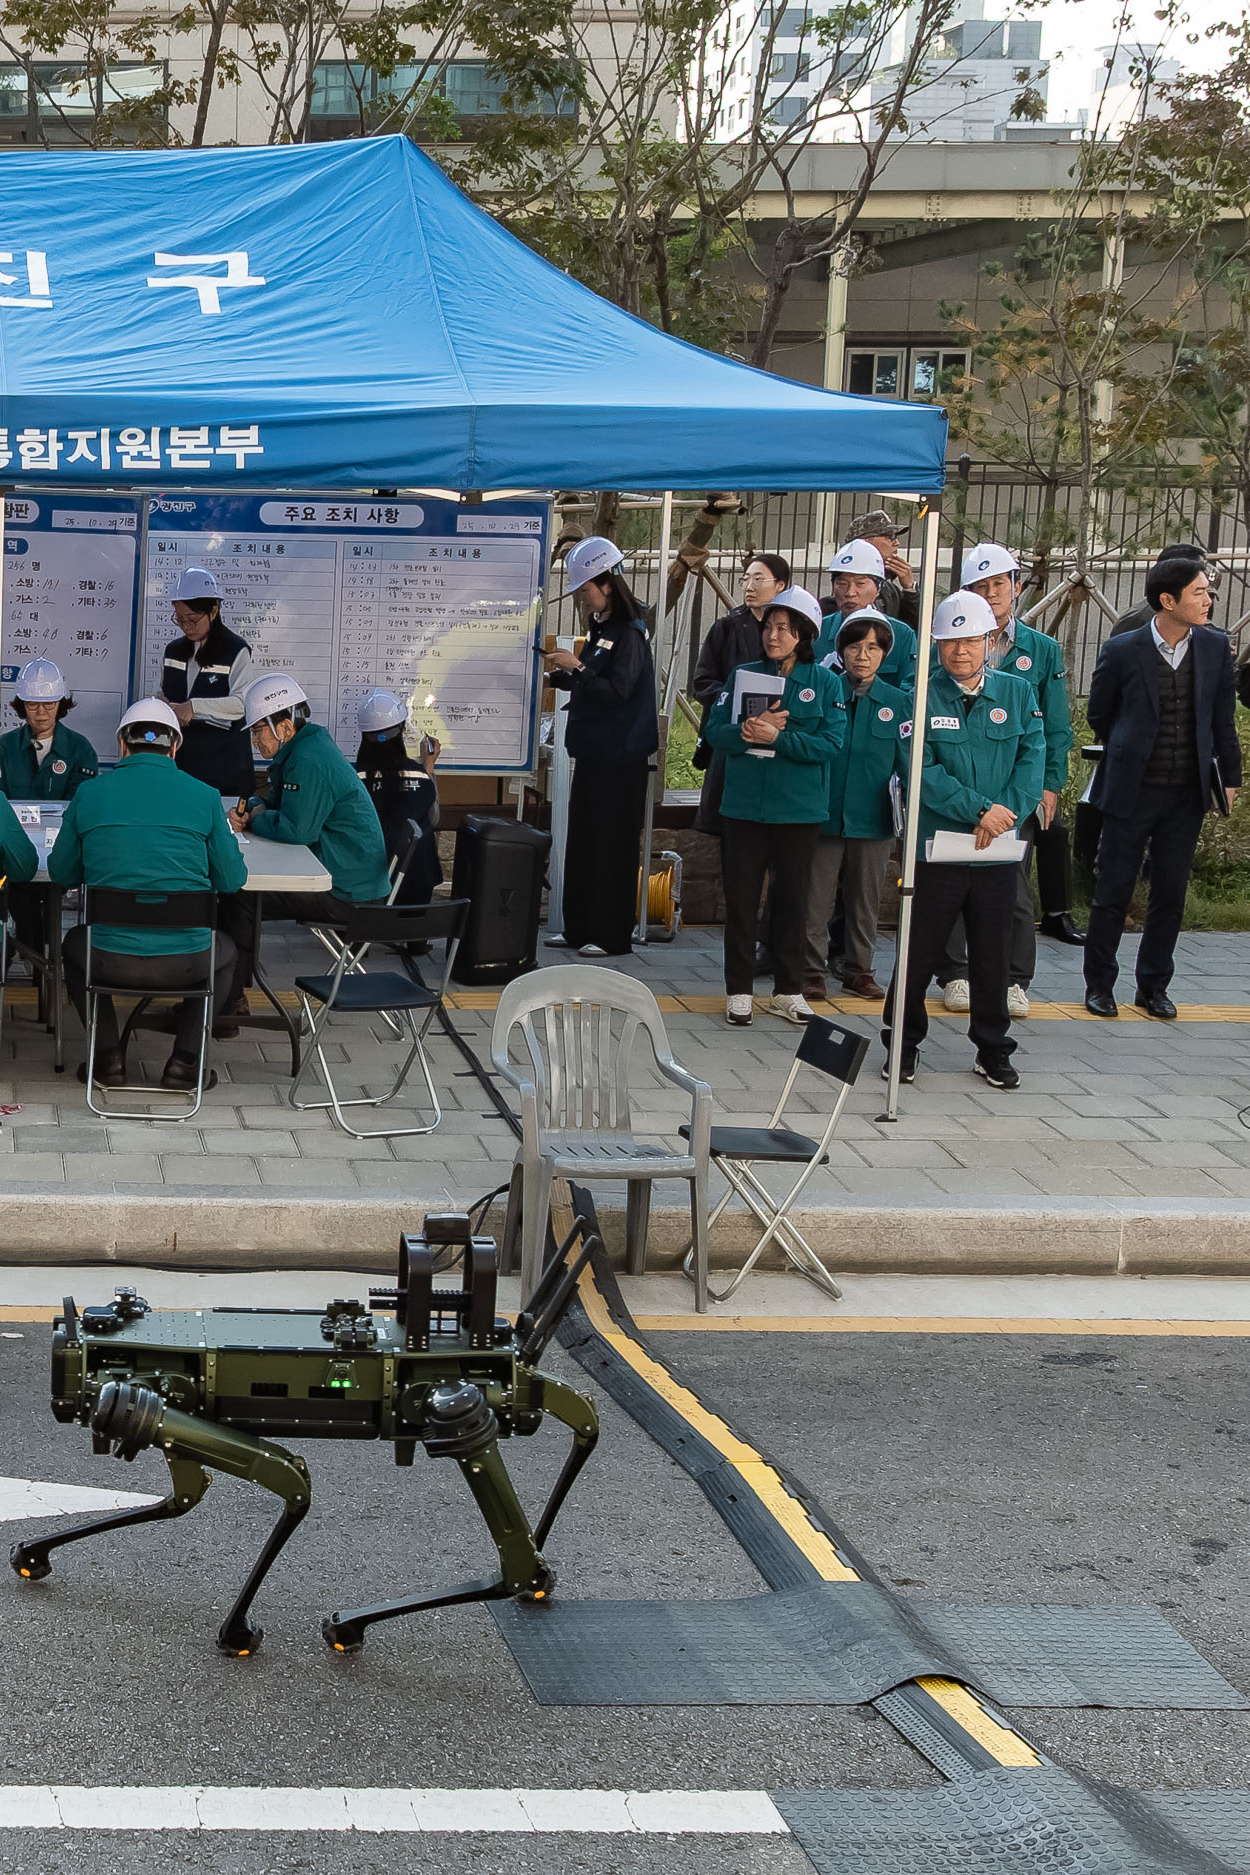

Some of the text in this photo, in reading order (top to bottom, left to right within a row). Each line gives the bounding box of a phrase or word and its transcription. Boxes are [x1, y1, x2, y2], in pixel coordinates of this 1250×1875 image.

[160, 501, 196, 512] 광진구
[284, 506, 400, 524] 주요 조치 사항
[119, 517, 135, 527] 기준
[524, 521, 540, 531] 기준
[157, 541, 178, 552] 일시
[353, 546, 373, 556] 일시
[30, 611, 38, 621] 대
